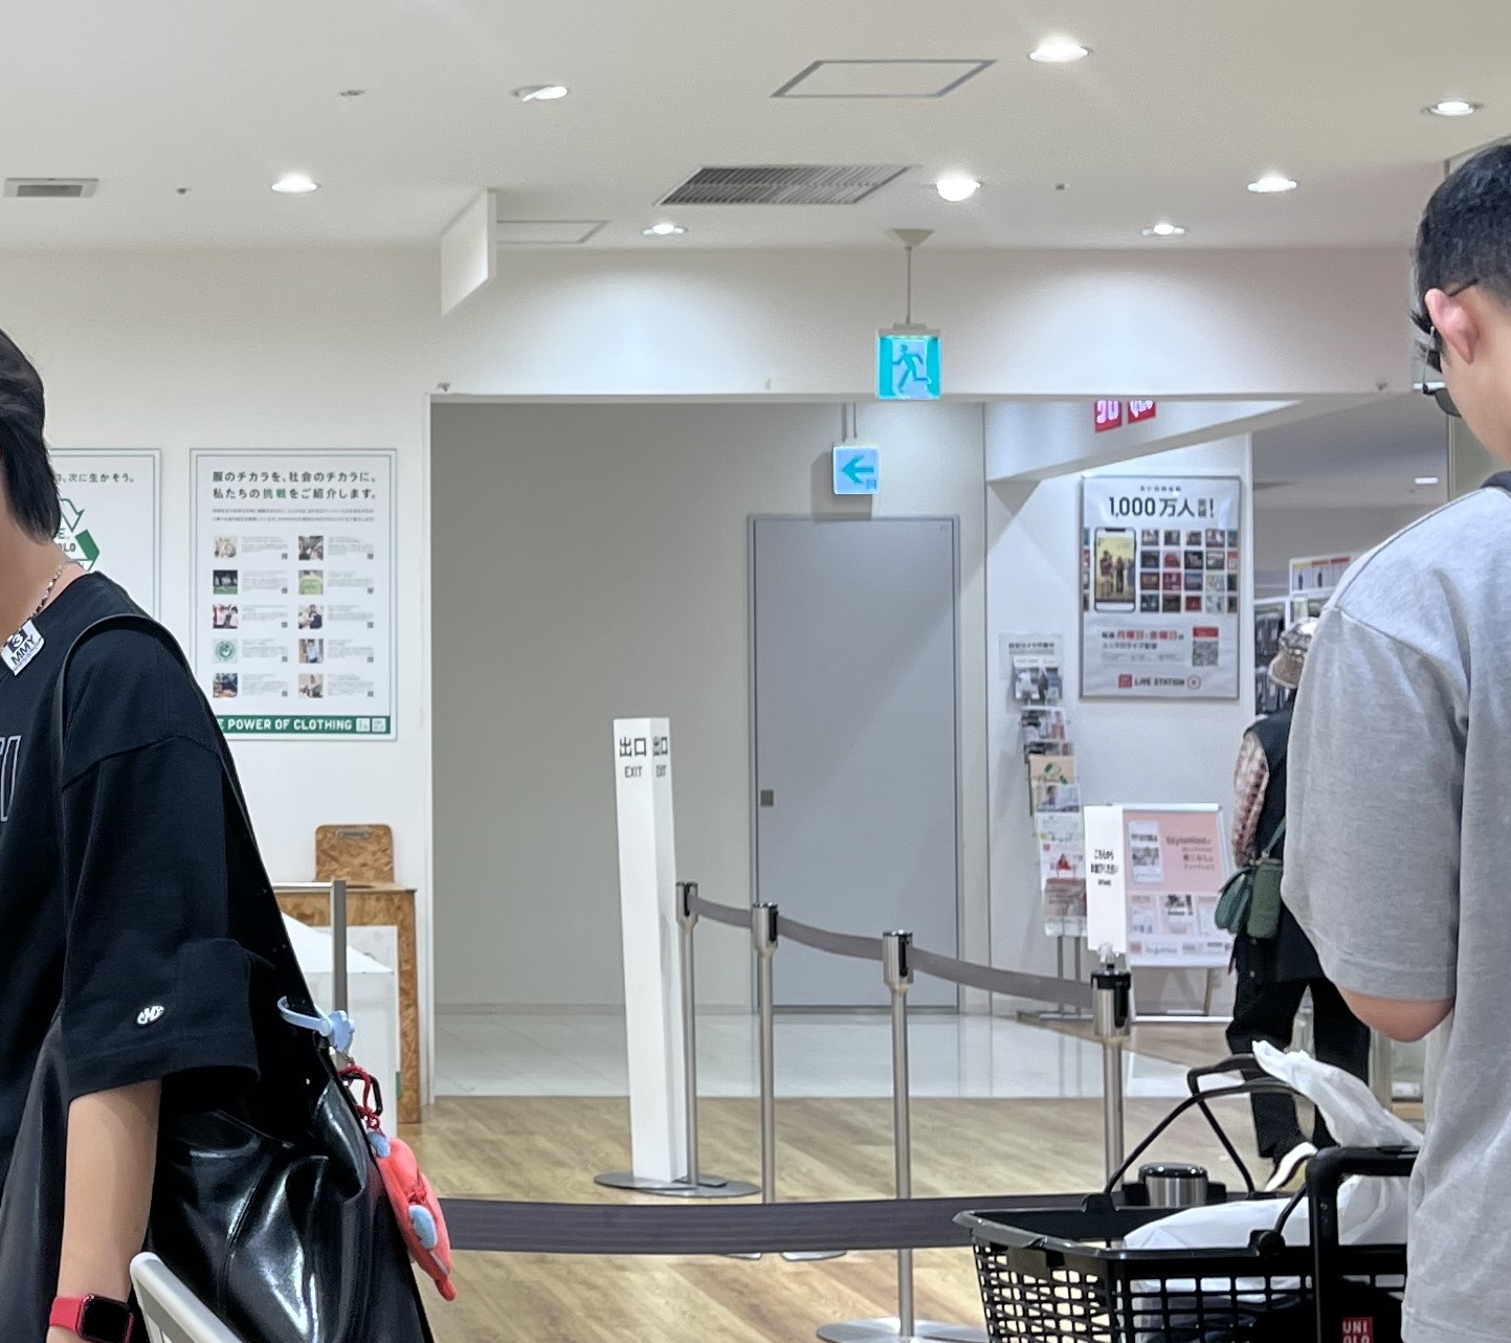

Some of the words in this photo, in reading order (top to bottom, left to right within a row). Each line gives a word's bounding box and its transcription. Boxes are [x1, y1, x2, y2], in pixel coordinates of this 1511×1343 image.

[212, 471, 376, 483] 服のチカラを、社会のチカラに。
[212, 488, 376, 500] 私たちの挑戦をご紹介します。
[11, 634, 35, 666] MMY
[227, 718, 271, 730] POWER
[274, 718, 290, 730] OF
[293, 718, 352, 731] CLOTHING
[619, 737, 646, 757] 出口
[1342, 1320, 1368, 1334] UNI
